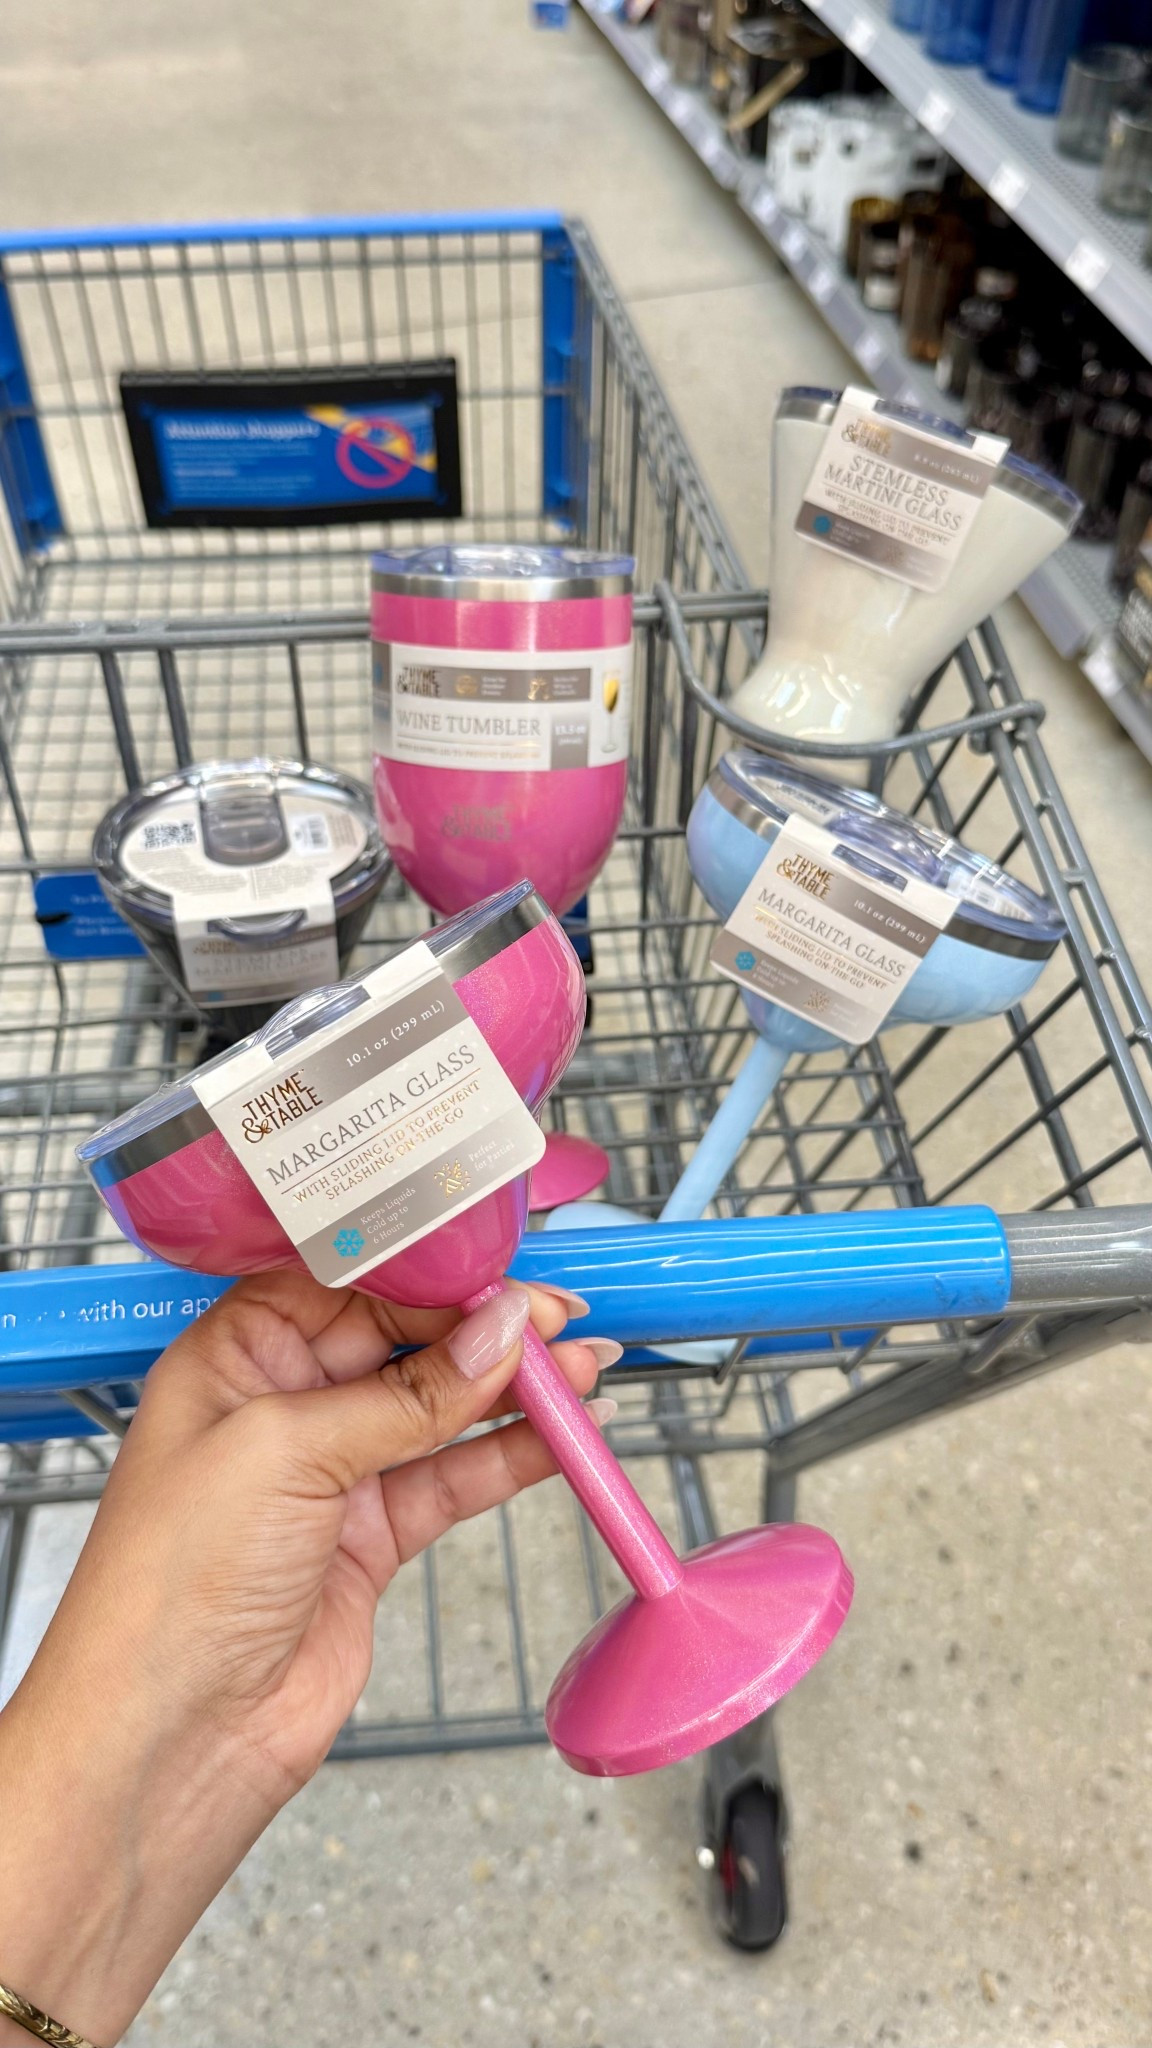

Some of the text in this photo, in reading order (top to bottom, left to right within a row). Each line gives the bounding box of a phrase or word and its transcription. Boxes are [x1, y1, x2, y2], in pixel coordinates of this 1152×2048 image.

[824, 463, 903, 508] MARTINI
[904, 498, 963, 532] GLASS
[850, 455, 949, 506] STEMLESS
[396, 710, 541, 737] WINE TUMBLER
[791, 853, 835, 886] THYME
[757, 887, 852, 951] MARGARITA
[855, 942, 906, 977] GLASS
[853, 899, 926, 944] 10.1 oz (299 mL)
[766, 931, 814, 962] SPLASHING
[779, 926, 816, 953] SLIDING
[816, 947, 832, 961] LID
[833, 957, 846, 968] TO
[846, 963, 887, 989] PREVENT
[346, 1000, 445, 1068] 10.1 oz (299 mL)
[242, 1070, 308, 1120] THYME
[266, 1045, 475, 1186] MARGARITA GLASS
[293, 1080, 481, 1203] WITH SLIDING LID TO PREVENT
[325, 1107, 464, 1201] SPLASHING ON-THE-GO
[468, 1141, 497, 1162] Perfect
[474, 1159, 488, 1172] for
[360, 1186, 416, 1225] Keeps Liquids
[367, 1205, 409, 1234] Cold up to
[373, 1222, 405, 1244] 6 Hours
[132, 1300, 174, 1319] our
[181, 1296, 220, 1318] ap
